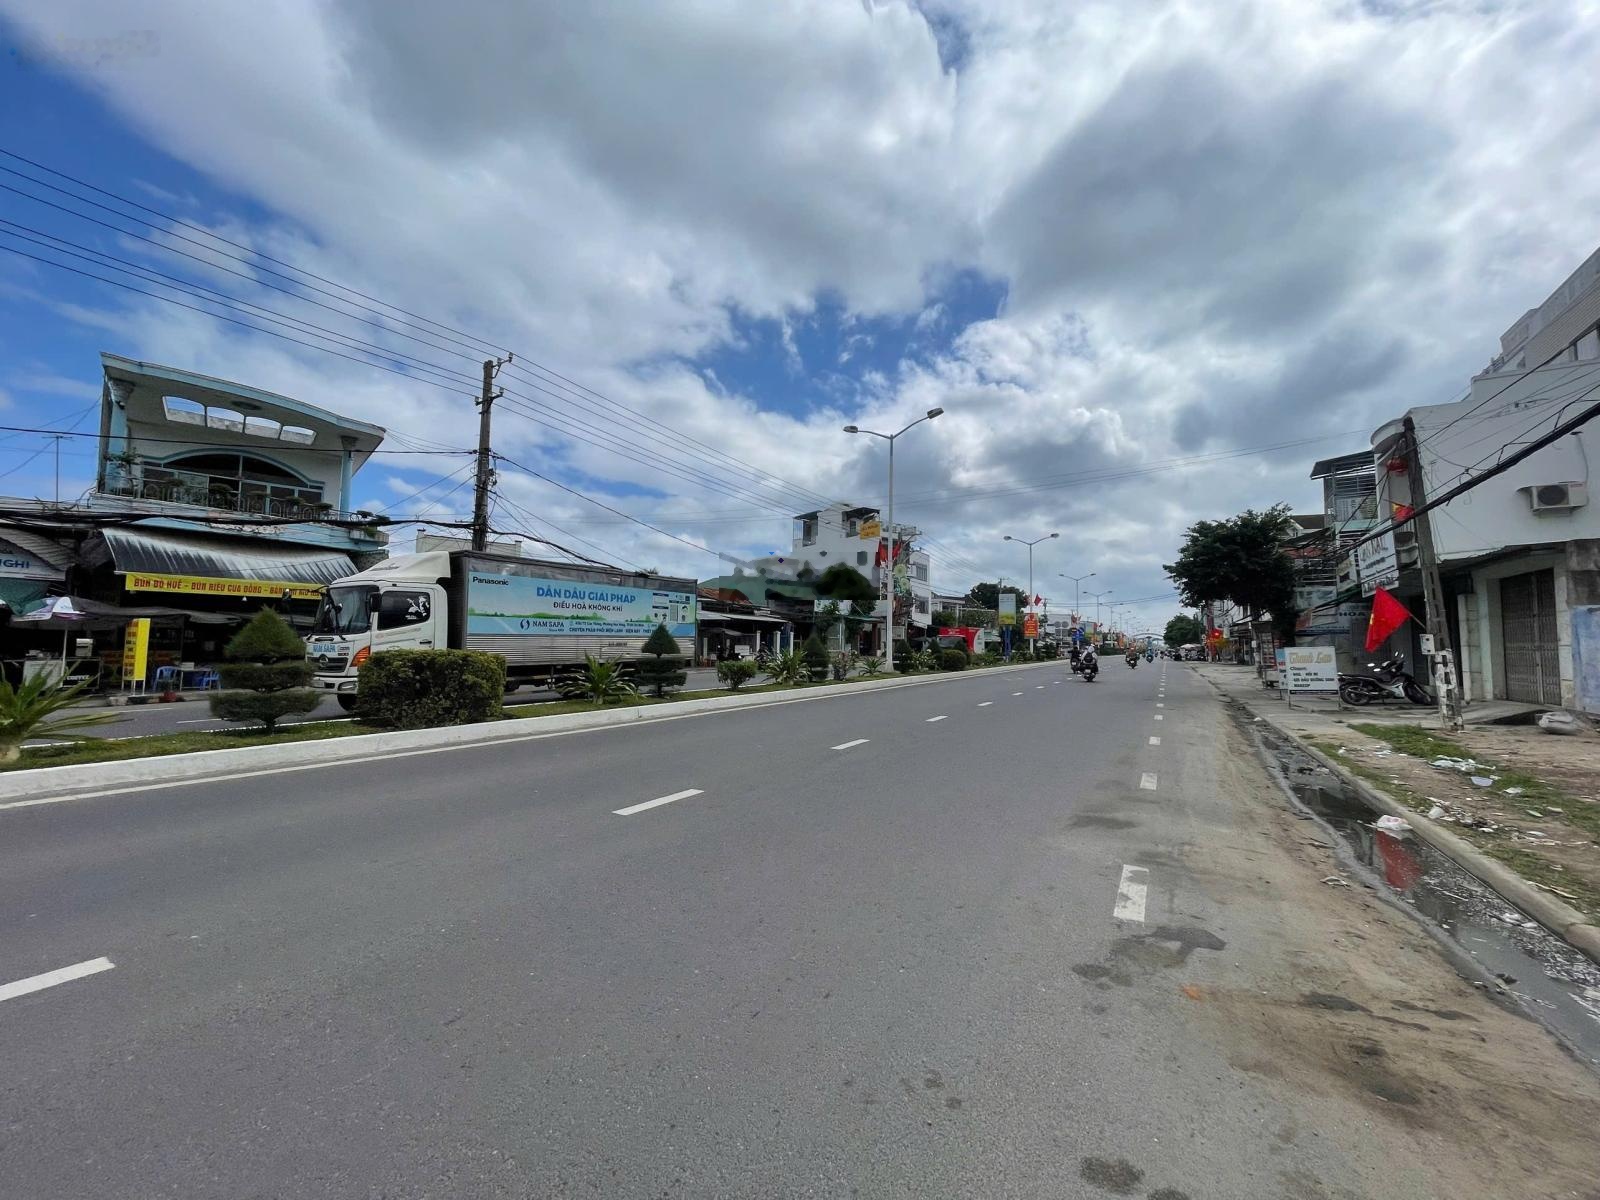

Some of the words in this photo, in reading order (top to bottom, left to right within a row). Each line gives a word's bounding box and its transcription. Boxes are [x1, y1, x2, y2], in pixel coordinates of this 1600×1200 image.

[0, 559, 30, 569] GHI
[472, 576, 509, 586] Panasonic
[532, 620, 548, 628] NAM
